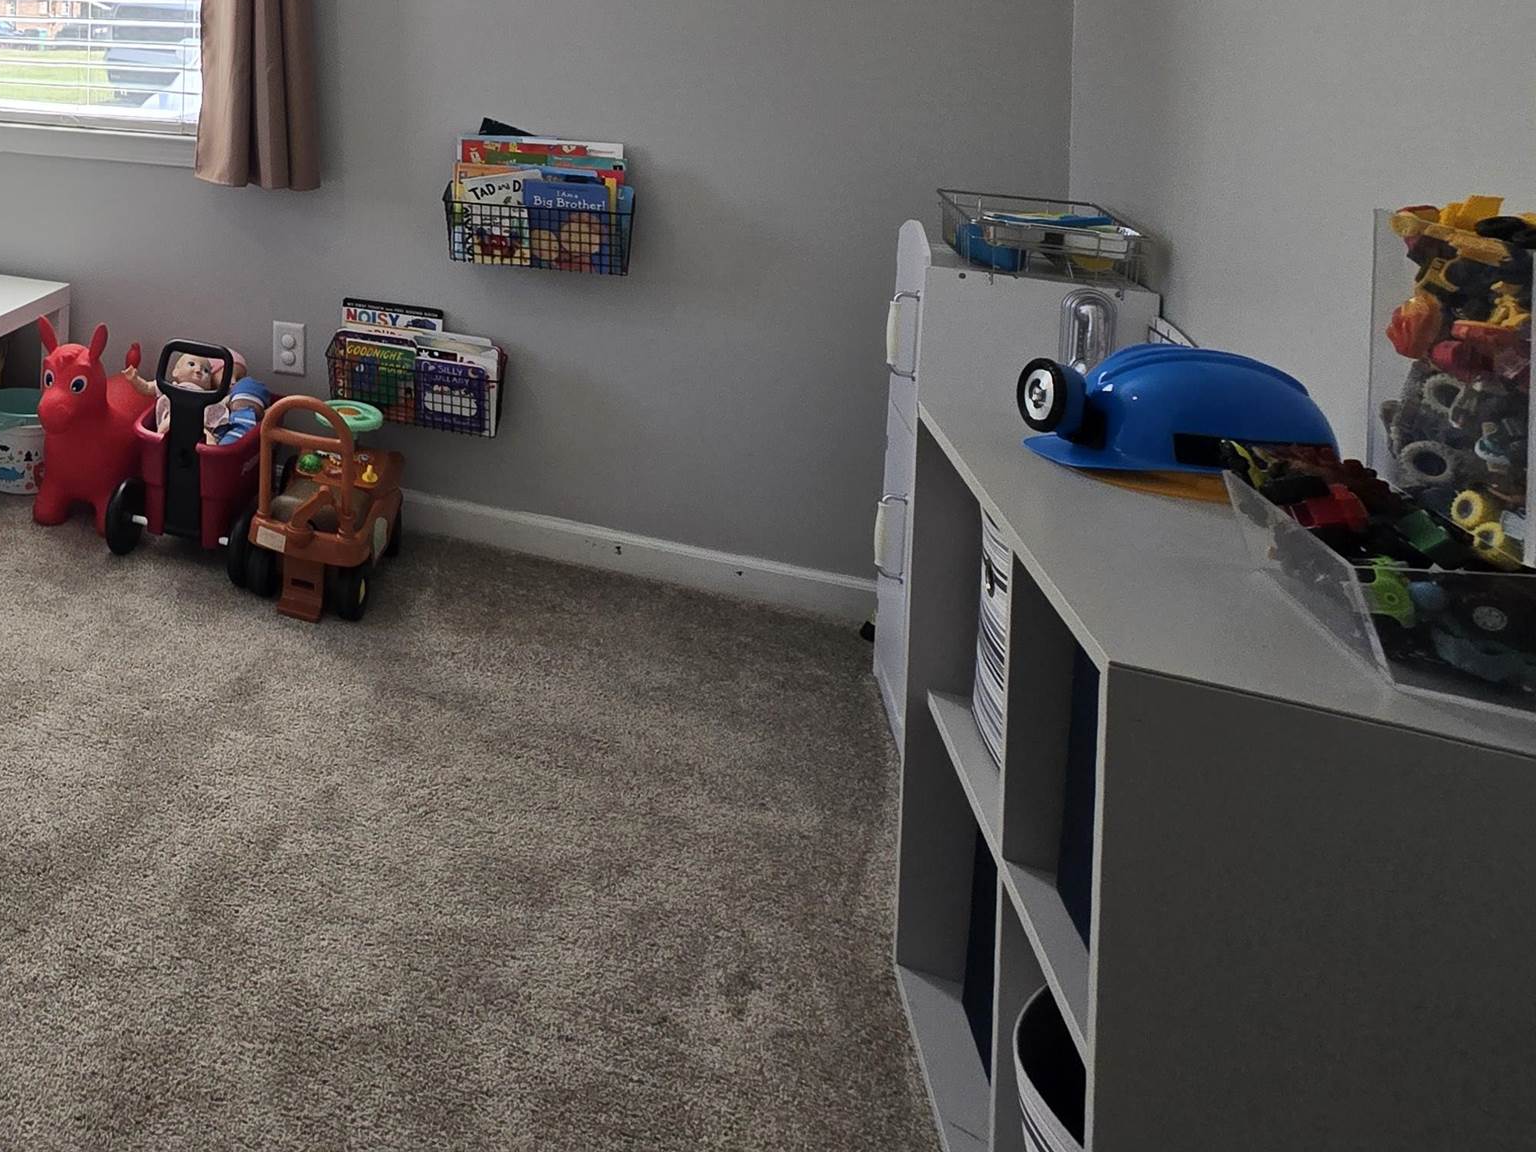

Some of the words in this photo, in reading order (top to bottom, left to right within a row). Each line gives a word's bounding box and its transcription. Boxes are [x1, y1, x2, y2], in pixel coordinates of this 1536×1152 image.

[468, 183, 496, 200] TAD
[533, 195, 553, 209] Big
[556, 197, 606, 211] Brother!
[346, 308, 400, 327] NOISY
[346, 344, 404, 361] GOODNIGHT
[437, 364, 464, 377] SILLY
